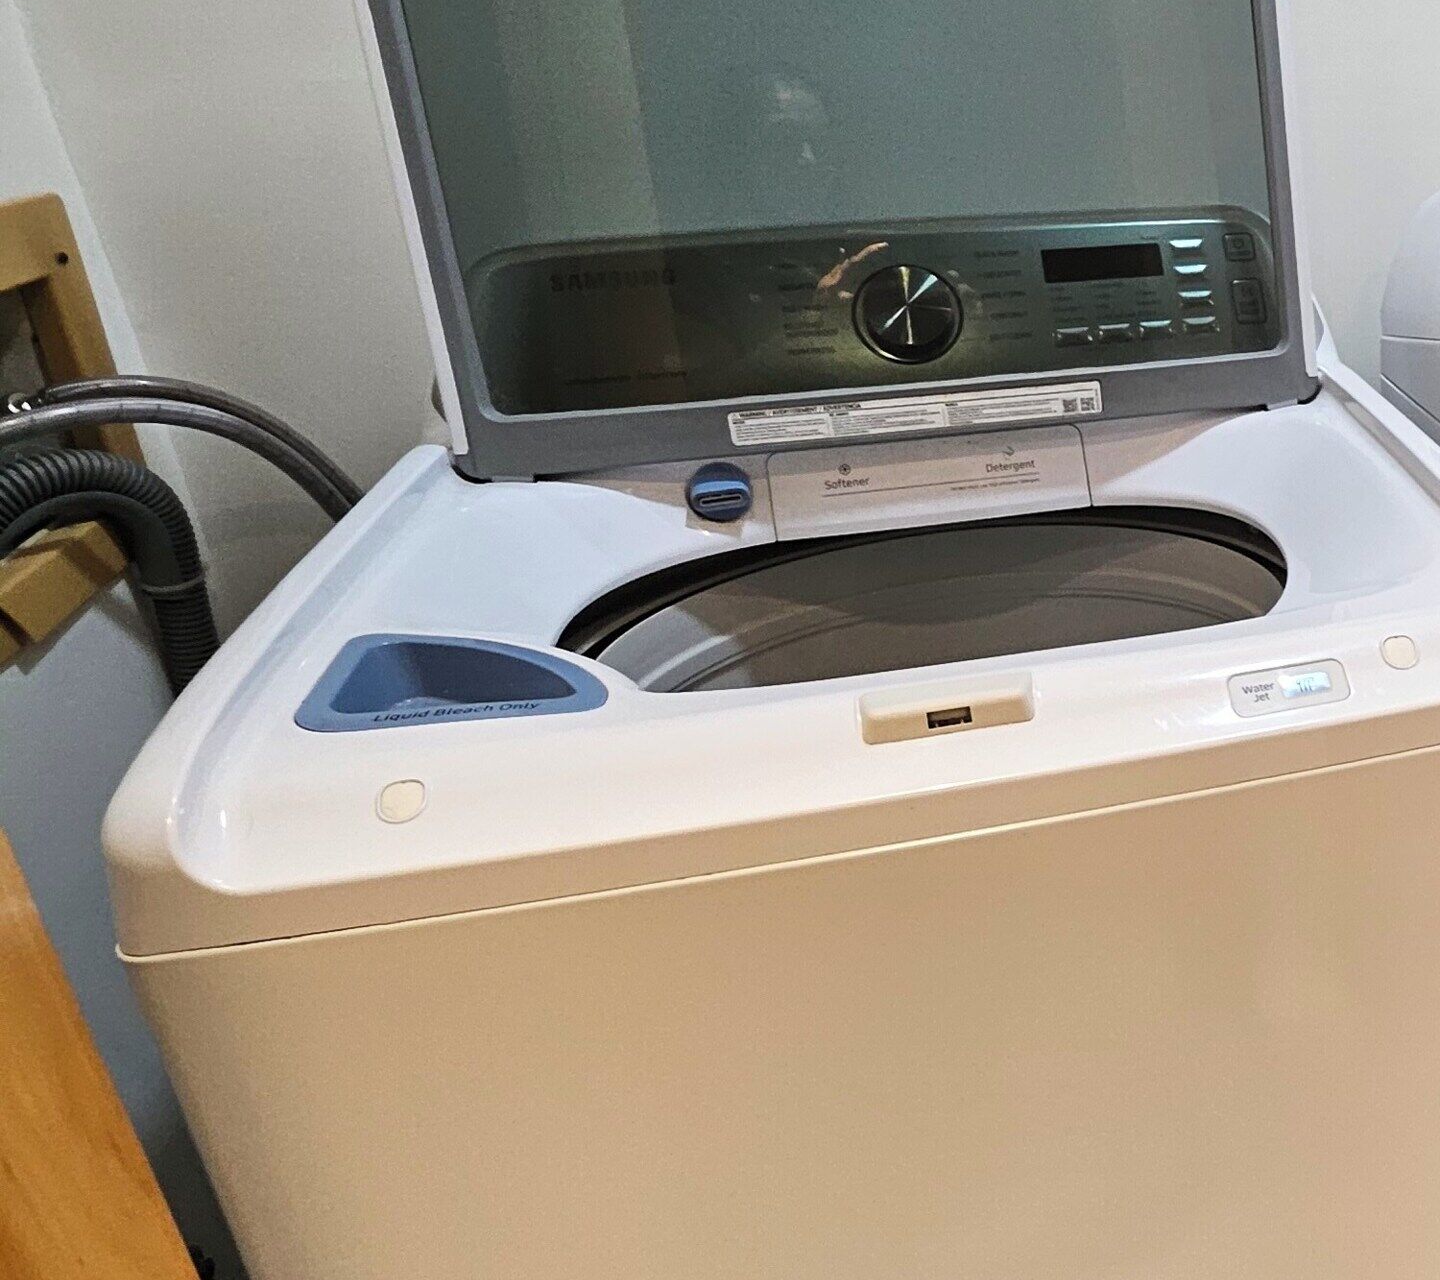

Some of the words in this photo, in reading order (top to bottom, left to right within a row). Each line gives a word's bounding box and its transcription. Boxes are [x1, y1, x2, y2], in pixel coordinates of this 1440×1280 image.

[985, 459, 1036, 474] Detergent
[824, 476, 870, 490] Softener
[1241, 681, 1275, 695] Water
[1253, 692, 1271, 703] Jet
[373, 709, 431, 722] Liquid
[433, 704, 494, 717] Bleach
[499, 701, 541, 711] Only
